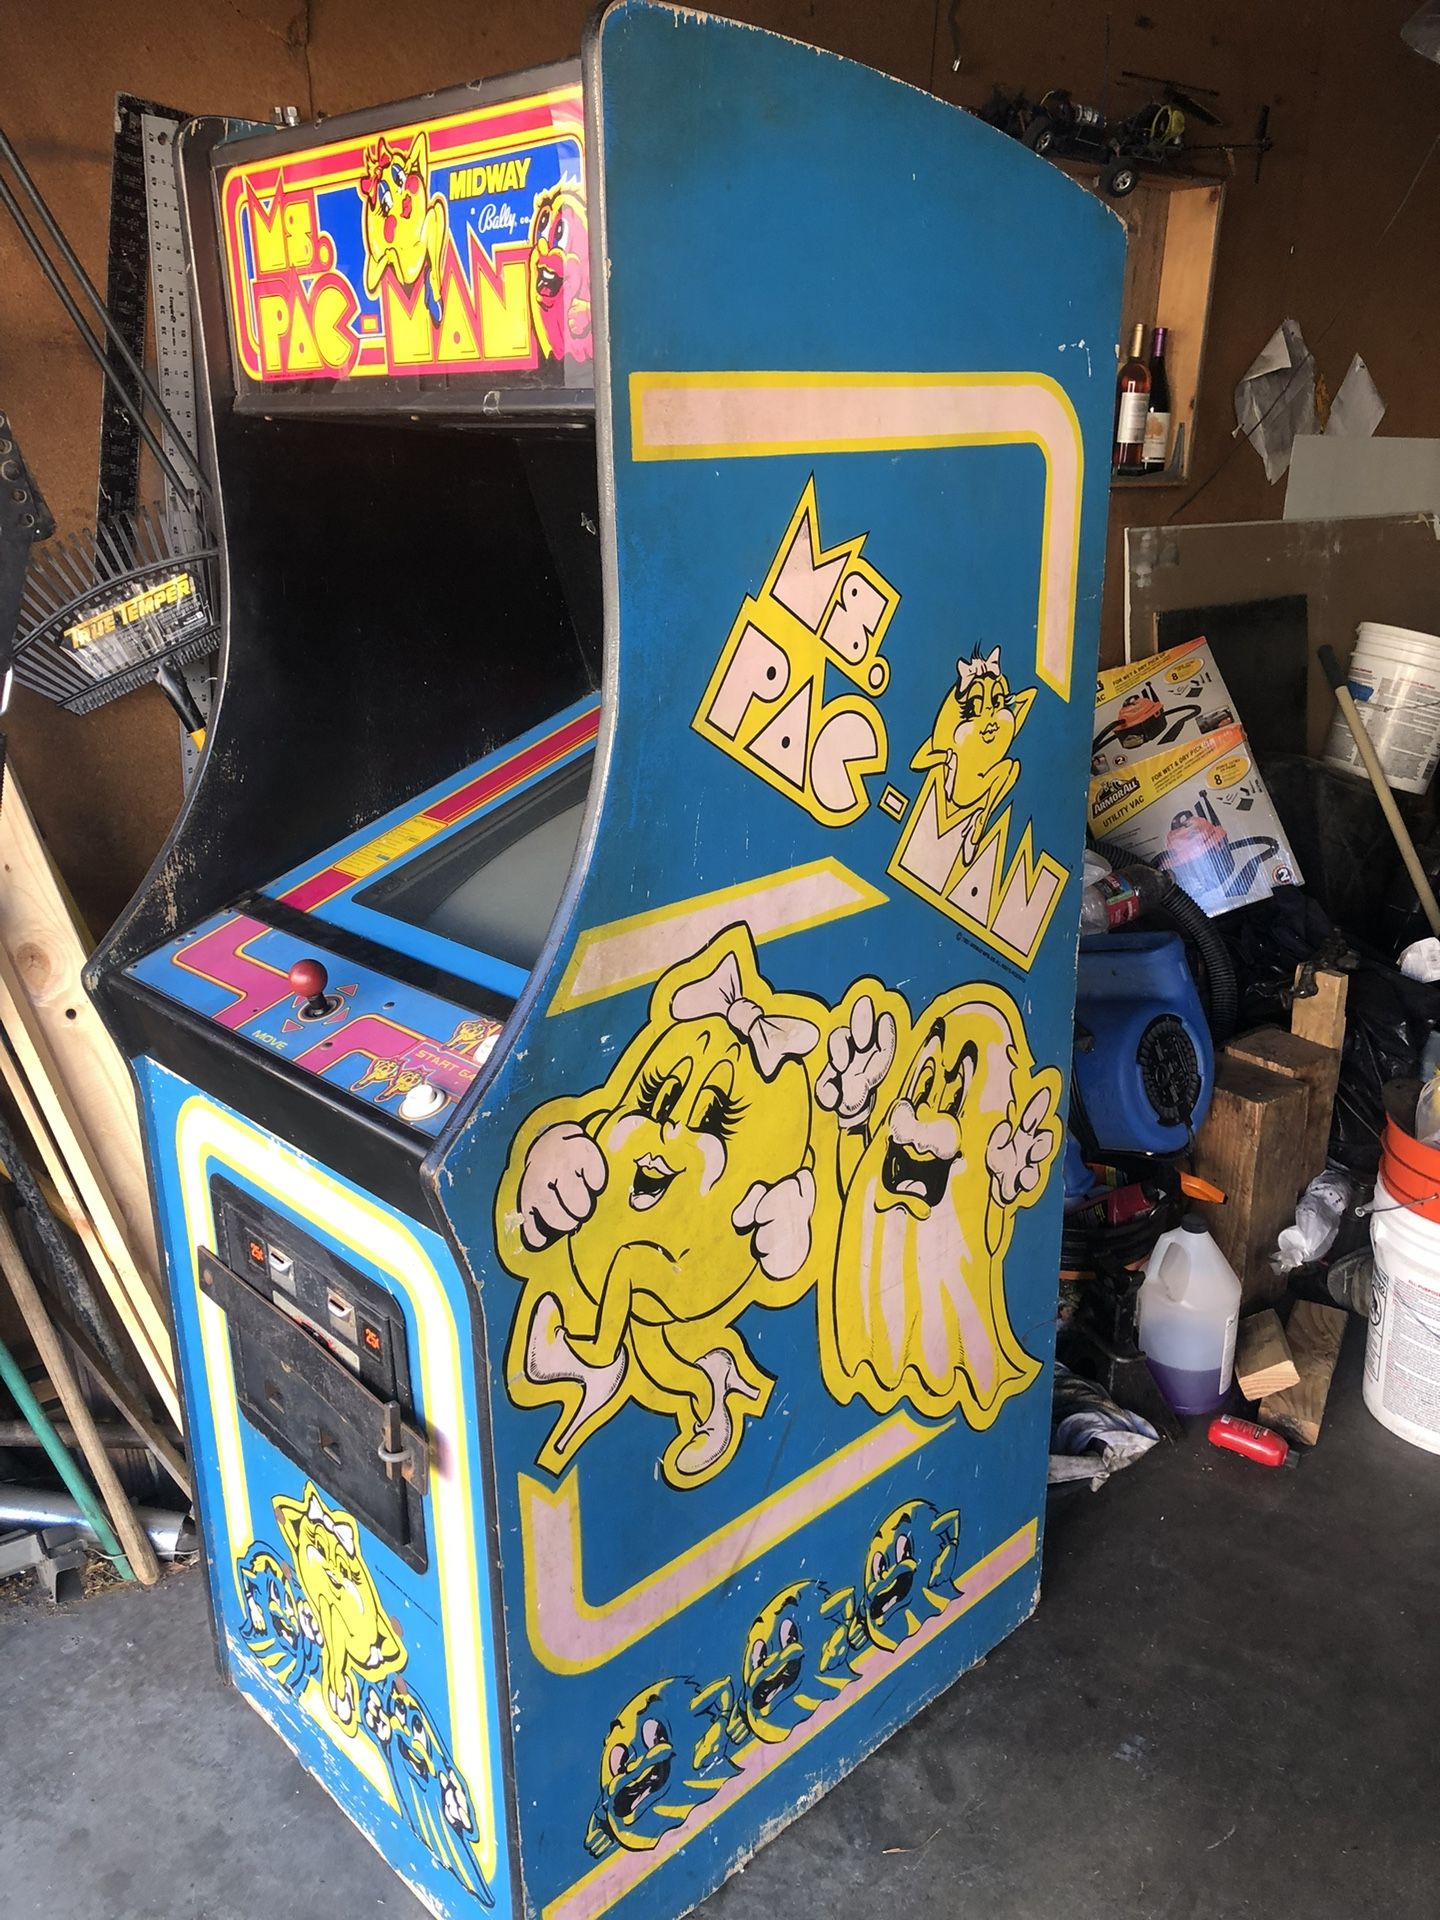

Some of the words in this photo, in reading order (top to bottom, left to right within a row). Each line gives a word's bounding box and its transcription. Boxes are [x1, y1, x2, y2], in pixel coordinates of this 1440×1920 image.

[449, 157, 532, 202] MIDWAY
[478, 203, 514, 235] Bally
[255, 236, 538, 376] PAC-MAN
[64, 611, 116, 649] TRUE
[113, 573, 192, 626] TEMPER
[1171, 672, 1178, 681] 8
[1151, 771, 1162, 782] FOR
[1162, 765, 1174, 776] WET
[1179, 754, 1190, 765] DRY
[1190, 745, 1203, 757] PICK
[1213, 774, 1223, 785] 8
[696, 602, 1066, 967] PAC-MAN
[1102, 805, 1130, 828] UTILITY
[1130, 795, 1145, 809] VAC
[1277, 868, 1289, 882] 2
[252, 1029, 289, 1050] MOVE
[415, 1049, 460, 1073] START
